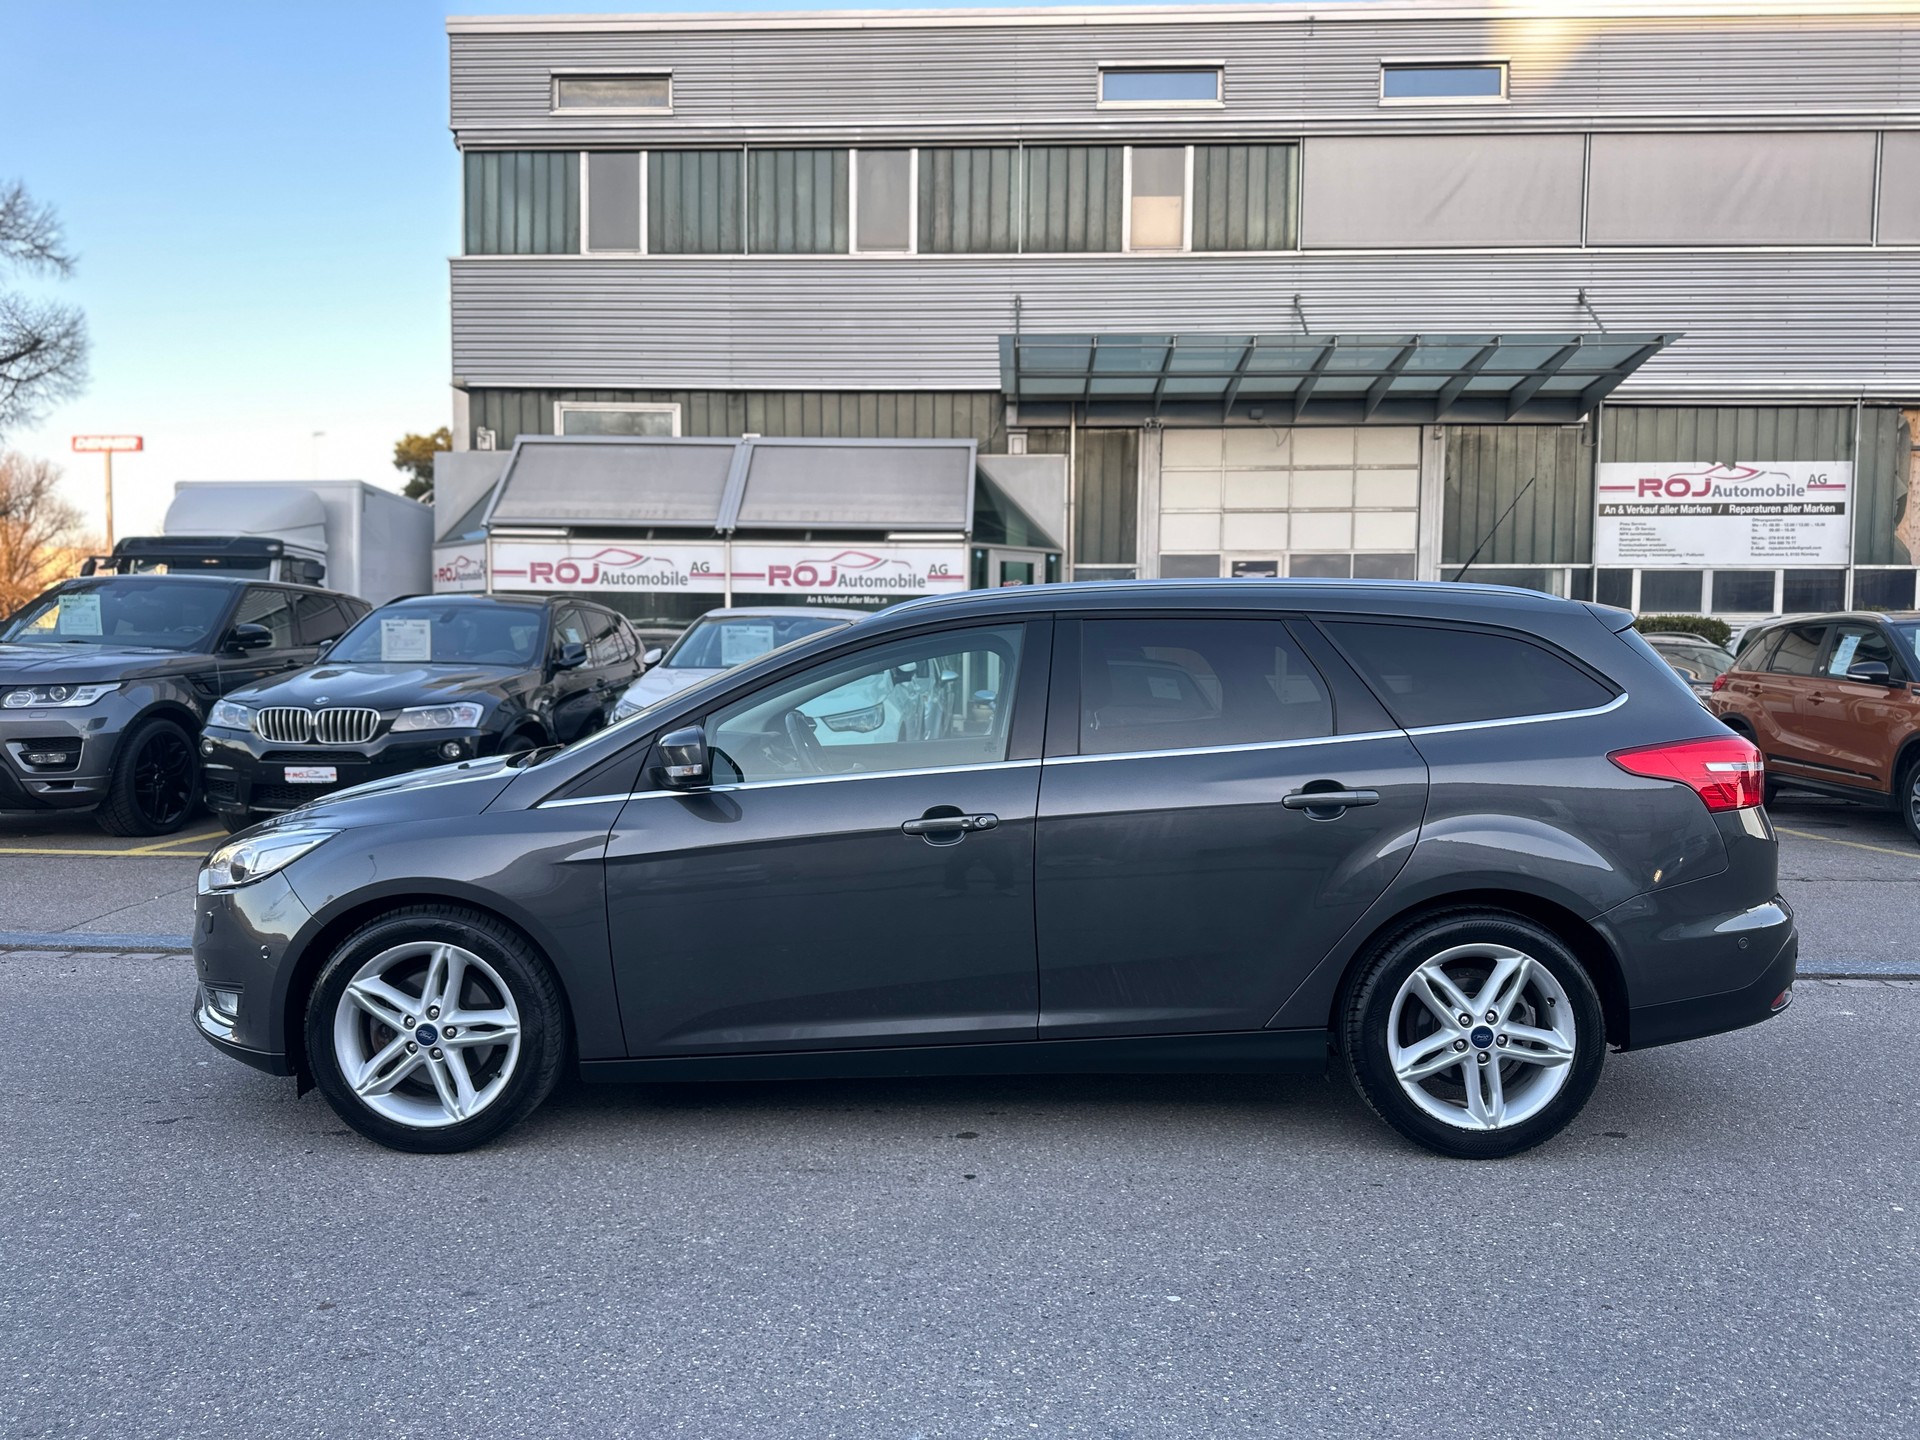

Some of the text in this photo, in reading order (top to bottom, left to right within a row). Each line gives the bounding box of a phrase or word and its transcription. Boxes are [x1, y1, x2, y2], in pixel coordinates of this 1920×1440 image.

[1638, 474, 1828, 498] ROJ Automobile AG
[1604, 505, 1616, 514] An
[1618, 505, 1625, 514] &
[1626, 505, 1658, 514] Verkauf
[1660, 505, 1679, 514] aller
[1680, 505, 1712, 514] Marken
[1729, 504, 1781, 515] Reparaturen
[1783, 504, 1802, 513] aller
[1803, 504, 1836, 513] Marken
[438, 566, 457, 582] ROJ
[529, 561, 710, 586] ROJ Automobile AG
[768, 563, 948, 588] ROJ Automobile AG
[806, 595, 816, 603] An
[823, 595, 848, 604] Verkauf
[848, 595, 863, 604] aller
